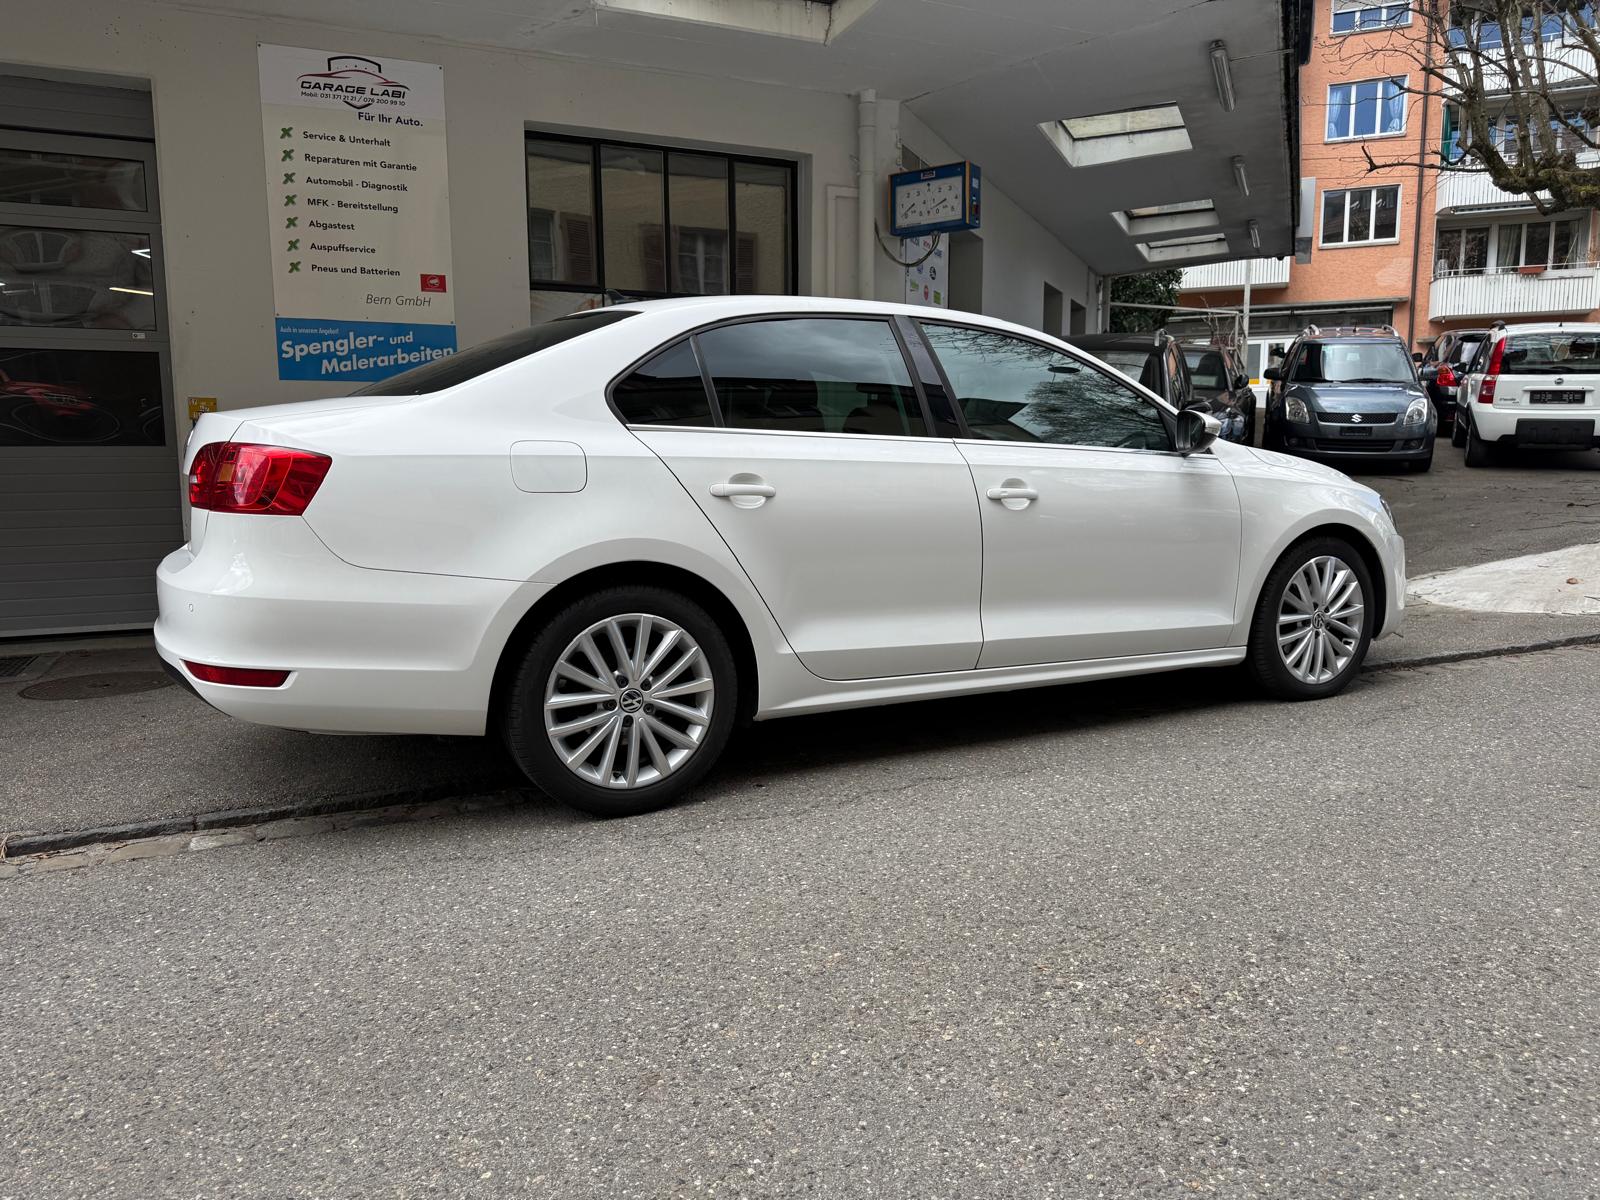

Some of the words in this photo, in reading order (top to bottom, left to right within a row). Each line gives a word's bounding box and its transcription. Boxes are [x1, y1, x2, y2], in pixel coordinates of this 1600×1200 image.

[300, 81, 366, 95] GARAGE
[370, 87, 406, 99] LABI
[358, 111, 375, 121] Für
[378, 113, 392, 123] Ihr
[395, 116, 423, 127] Auto.
[303, 131, 336, 142] Service
[339, 134, 346, 142] &
[349, 136, 391, 147] Unterhalt
[304, 153, 360, 167] Reparaturen
[363, 160, 378, 168] mit
[380, 161, 417, 171] Garantie
[306, 177, 353, 187] Automobil
[361, 181, 408, 192] Diagnostik
[308, 198, 329, 207] MFK
[337, 201, 399, 214] Bereitstellung
[309, 220, 355, 231] Abgastest
[310, 243, 376, 254] Auspuffservice
[311, 264, 338, 273] Pneus
[341, 265, 357, 274] und
[360, 267, 401, 276] Batterien
[366, 294, 392, 305] Bern
[395, 295, 432, 307] GmbH
[281, 332, 384, 361] Spengler-
[389, 331, 414, 345] und
[321, 346, 454, 375] Malerarbeiten
